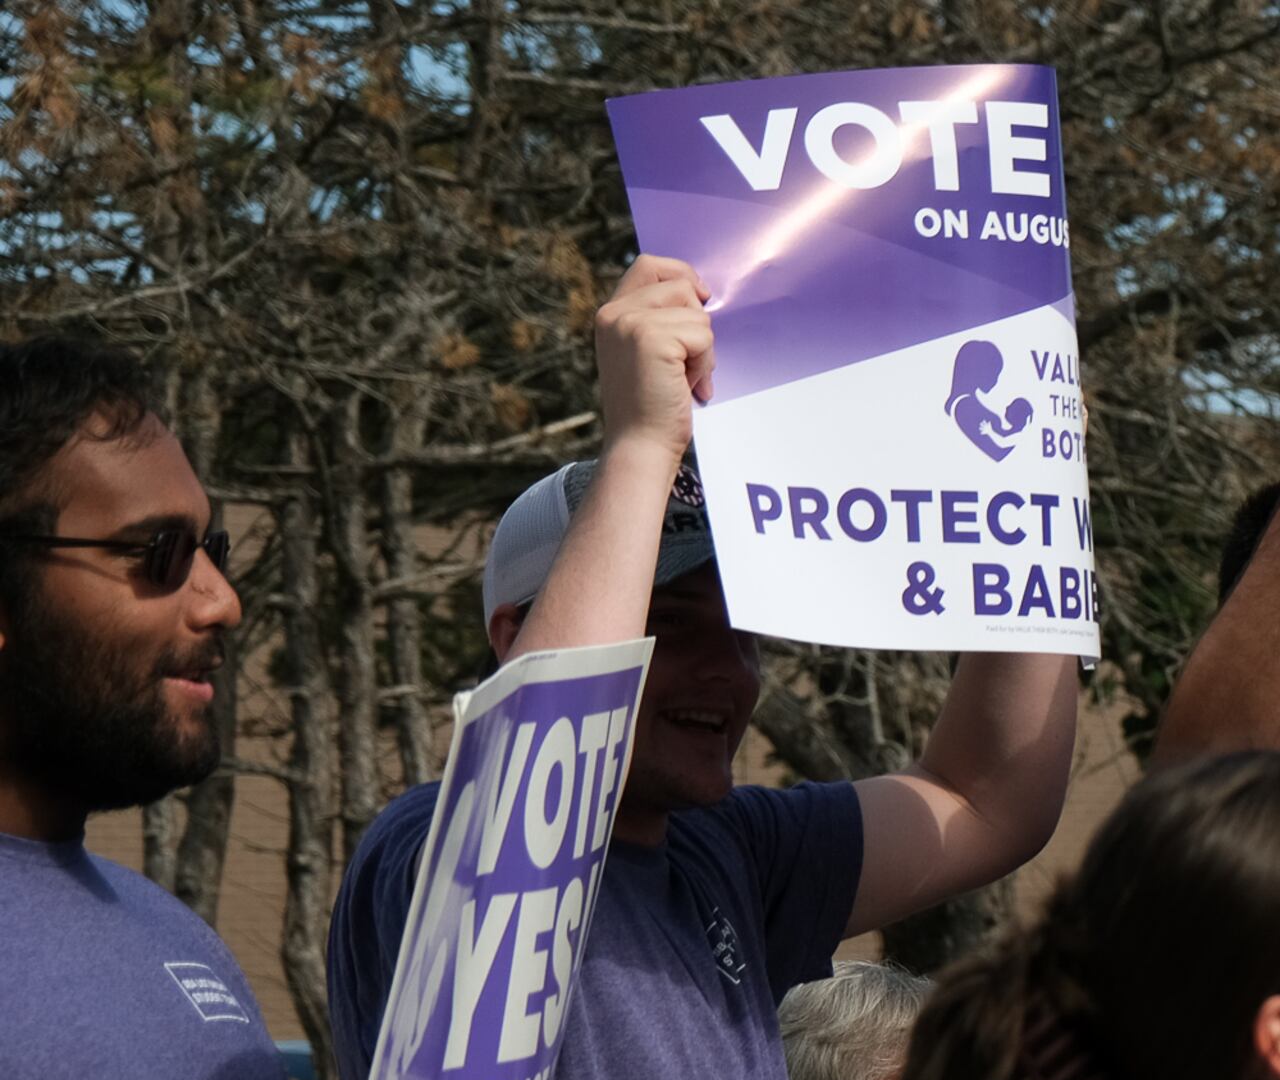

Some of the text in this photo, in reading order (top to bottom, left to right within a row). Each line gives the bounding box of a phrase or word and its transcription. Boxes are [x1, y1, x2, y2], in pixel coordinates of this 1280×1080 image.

[700, 101, 1051, 198] VOTE
[914, 207, 969, 239] ON
[746, 483, 1060, 547] PROTECT
[902, 561, 945, 616] &
[476, 705, 629, 878] VOTE
